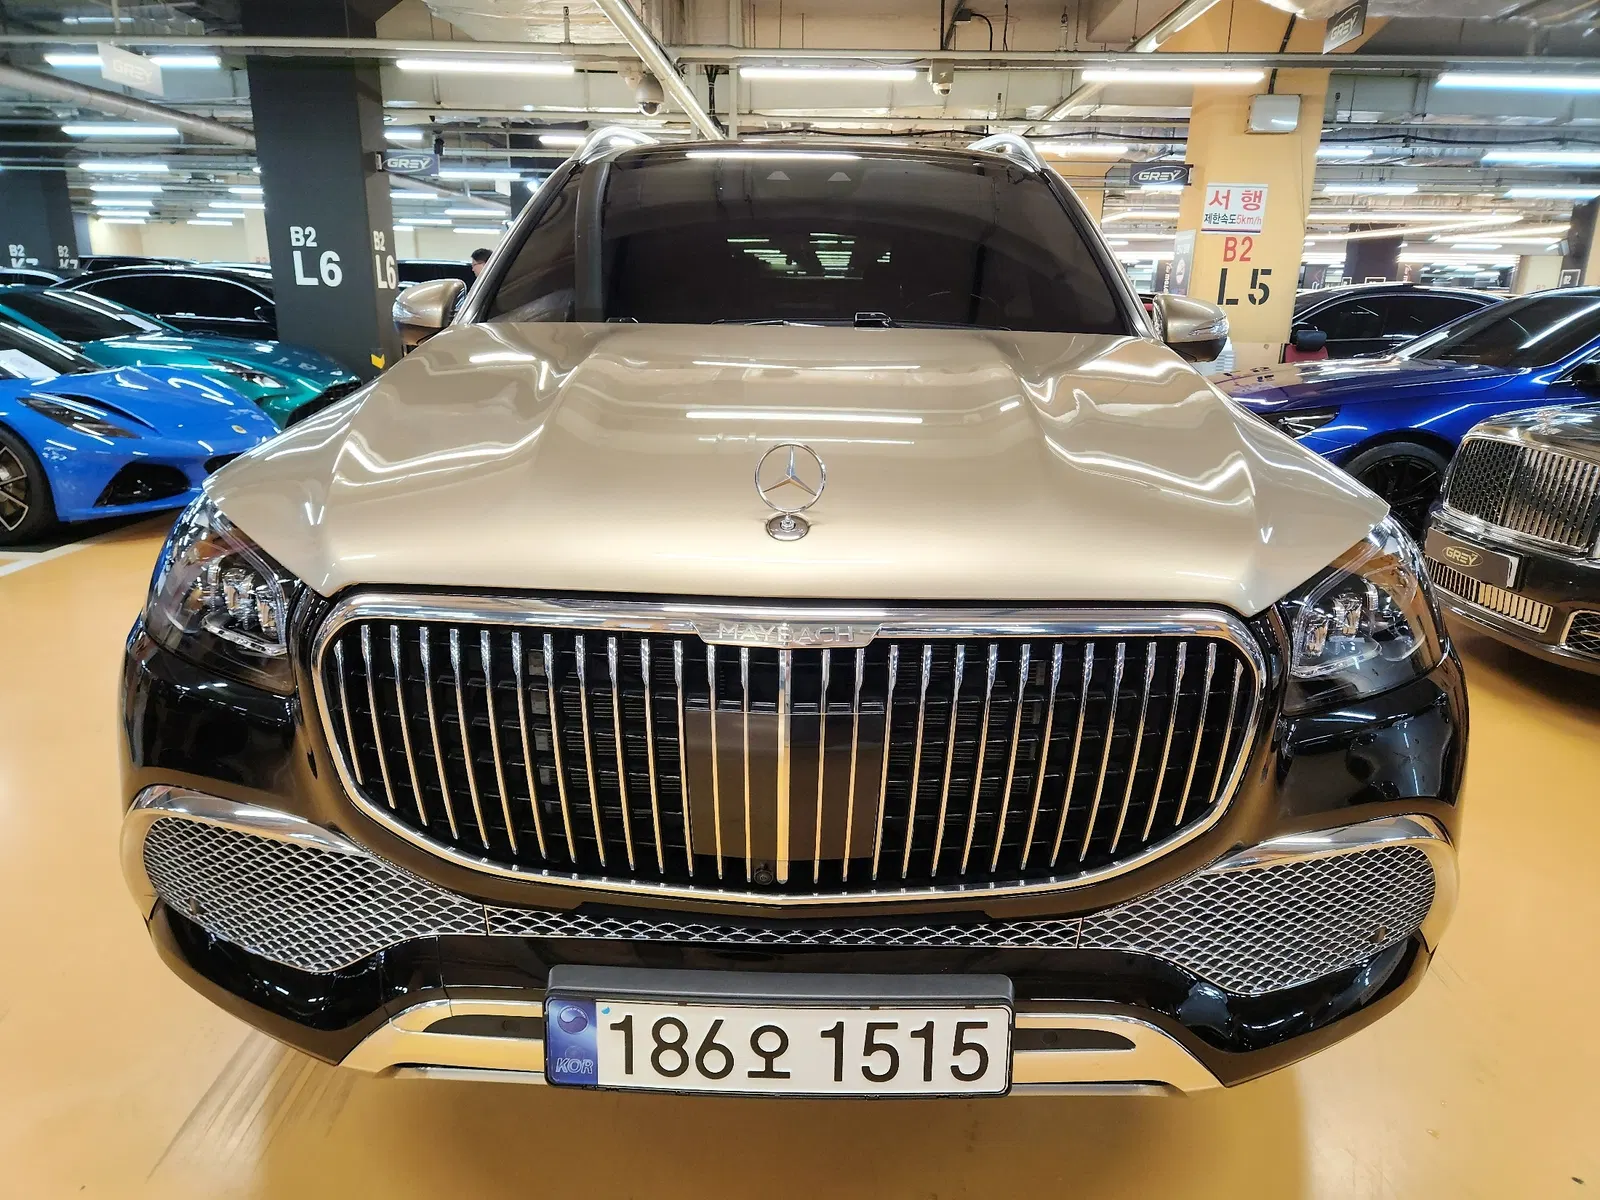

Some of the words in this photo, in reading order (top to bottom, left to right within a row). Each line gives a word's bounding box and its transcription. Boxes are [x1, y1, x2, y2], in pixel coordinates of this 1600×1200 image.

[1330, 10, 1359, 41] GREY
[113, 60, 153, 85] GREY
[387, 157, 431, 170] GREY
[1138, 169, 1182, 181] GREY
[290, 226, 318, 247] B2
[373, 230, 386, 251] B2
[8, 244, 26, 257] B2
[57, 245, 70, 257] B2
[1223, 236, 1254, 262] B2
[292, 250, 343, 287] L6
[375, 254, 397, 290] L6
[1446, 546, 1478, 566] GREY
[718, 622, 854, 643] MAYBACH
[609, 1014, 791, 1080] 186오
[820, 1020, 989, 1083] 1515
[555, 1057, 594, 1075] KOR
